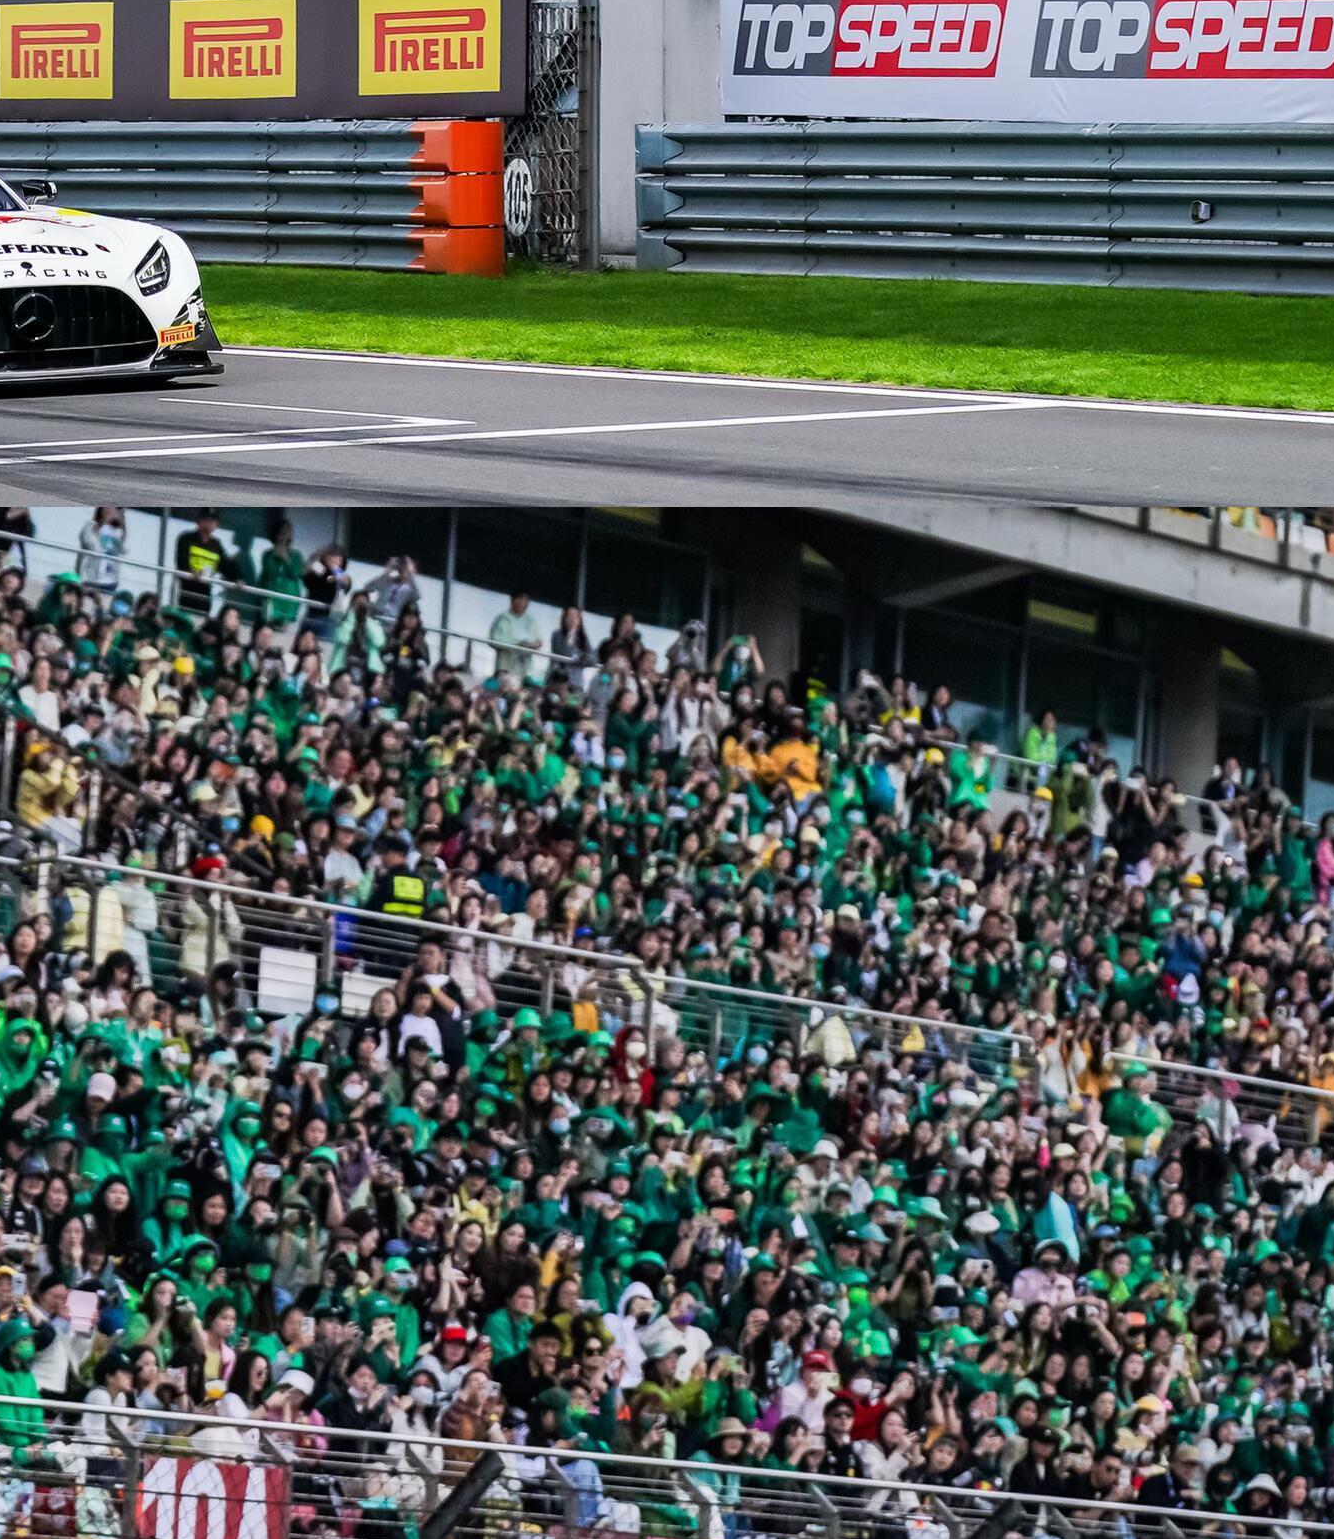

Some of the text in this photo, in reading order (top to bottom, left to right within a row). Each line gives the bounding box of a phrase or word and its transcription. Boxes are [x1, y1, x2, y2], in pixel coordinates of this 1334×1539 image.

[11, 23, 101, 79] PIRELLI
[183, 18, 283, 77] PIRELLI
[374, 8, 486, 72] PIRELLI
[161, 324, 193, 343] PIRELLI
